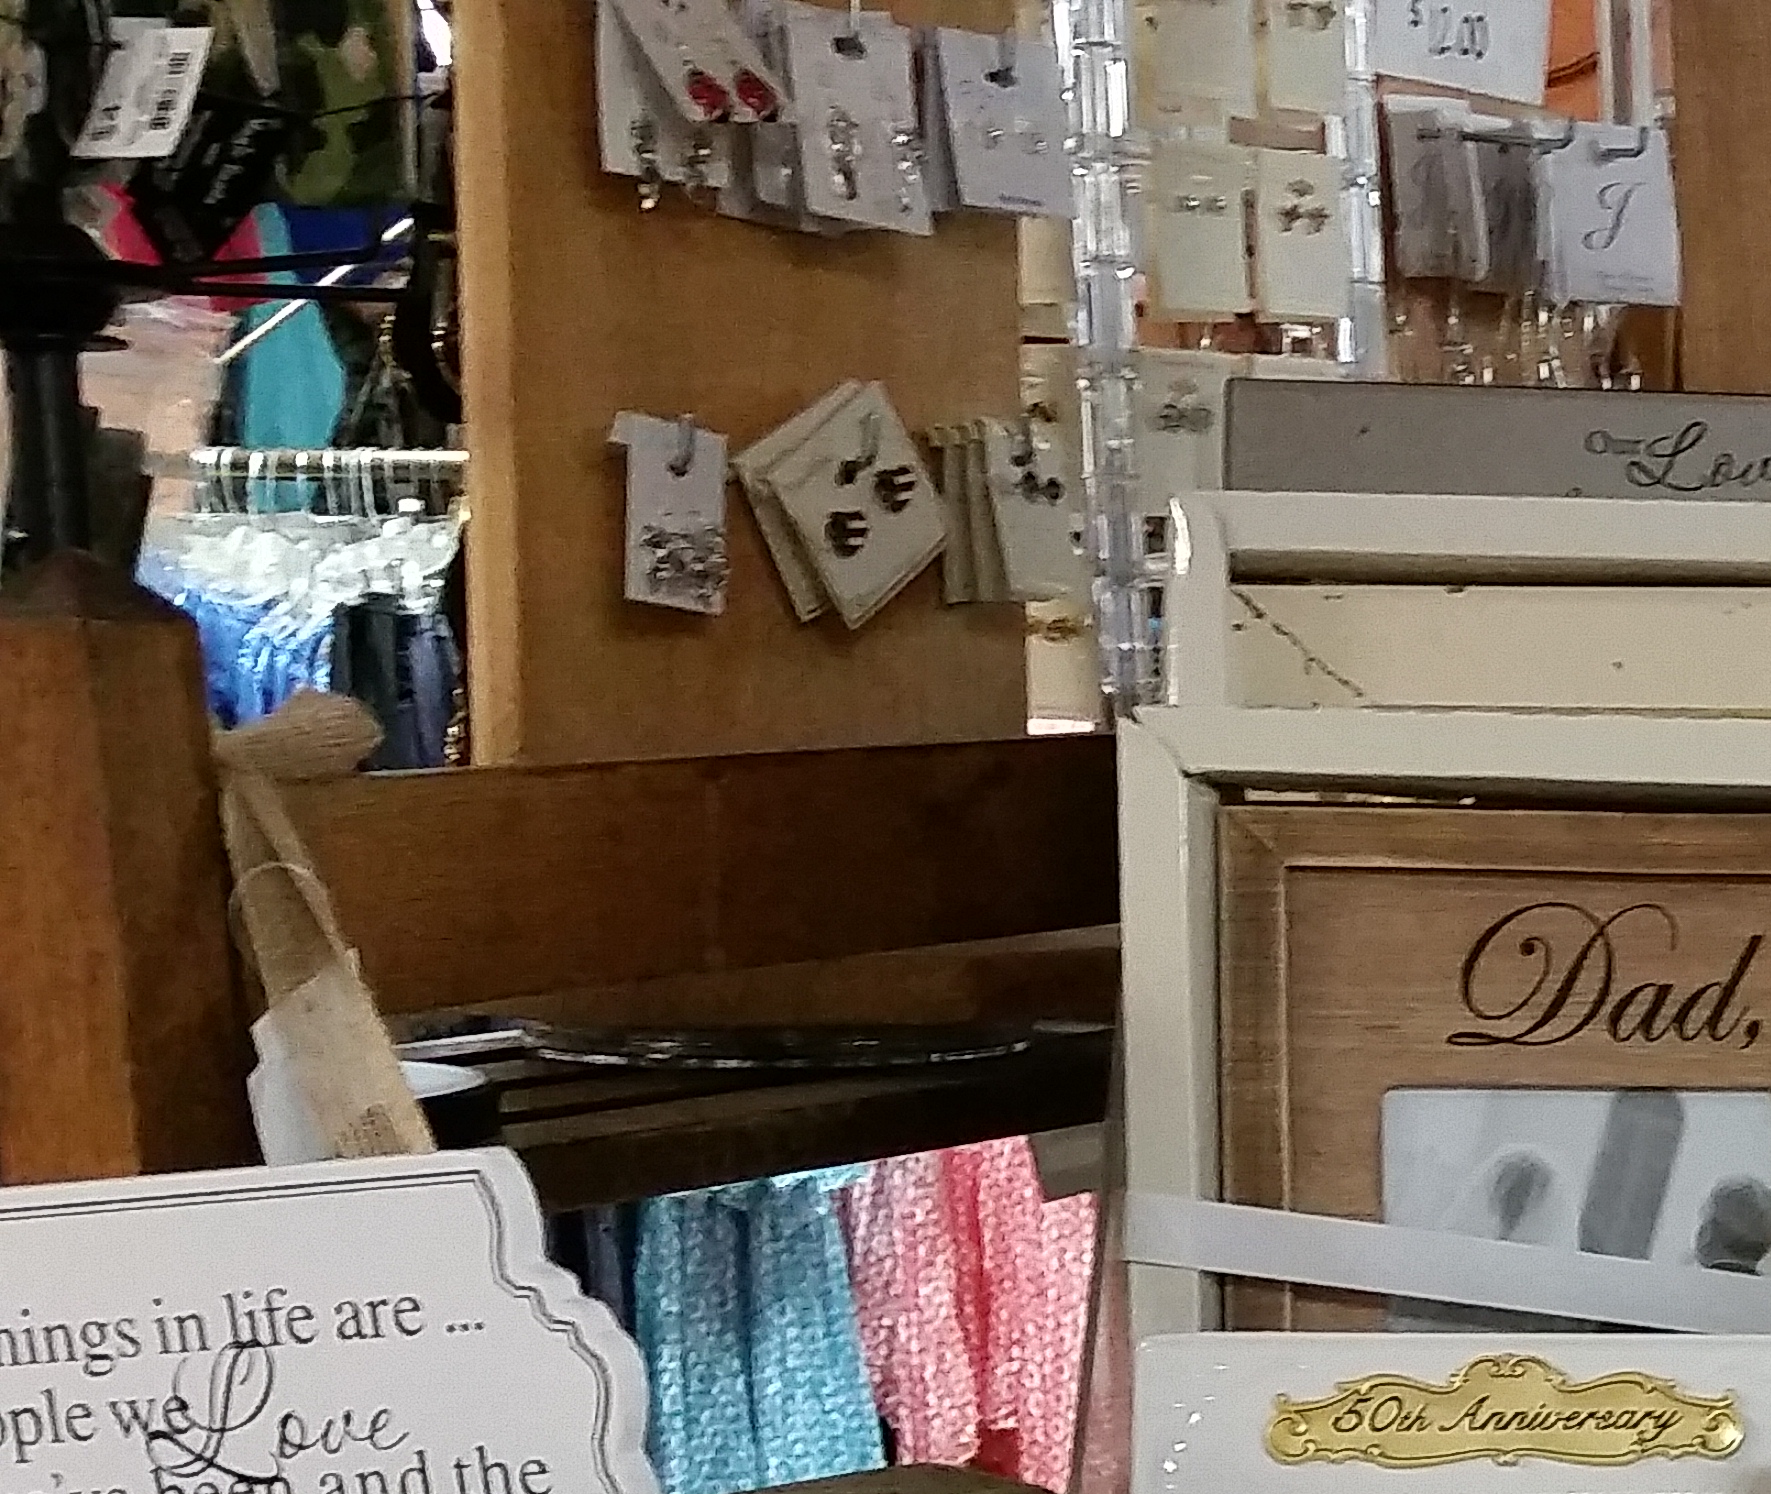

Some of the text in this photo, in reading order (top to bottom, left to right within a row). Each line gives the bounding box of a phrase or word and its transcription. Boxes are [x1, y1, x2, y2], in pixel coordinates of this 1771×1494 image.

[1446, 902, 1765, 1050] Dad,
[153, 1297, 211, 1355] in
[224, 1286, 318, 1347] life
[334, 1292, 425, 1341] are
[148, 1340, 410, 1485] Love
[1329, 1394, 1685, 1439] 50th Anniversary
